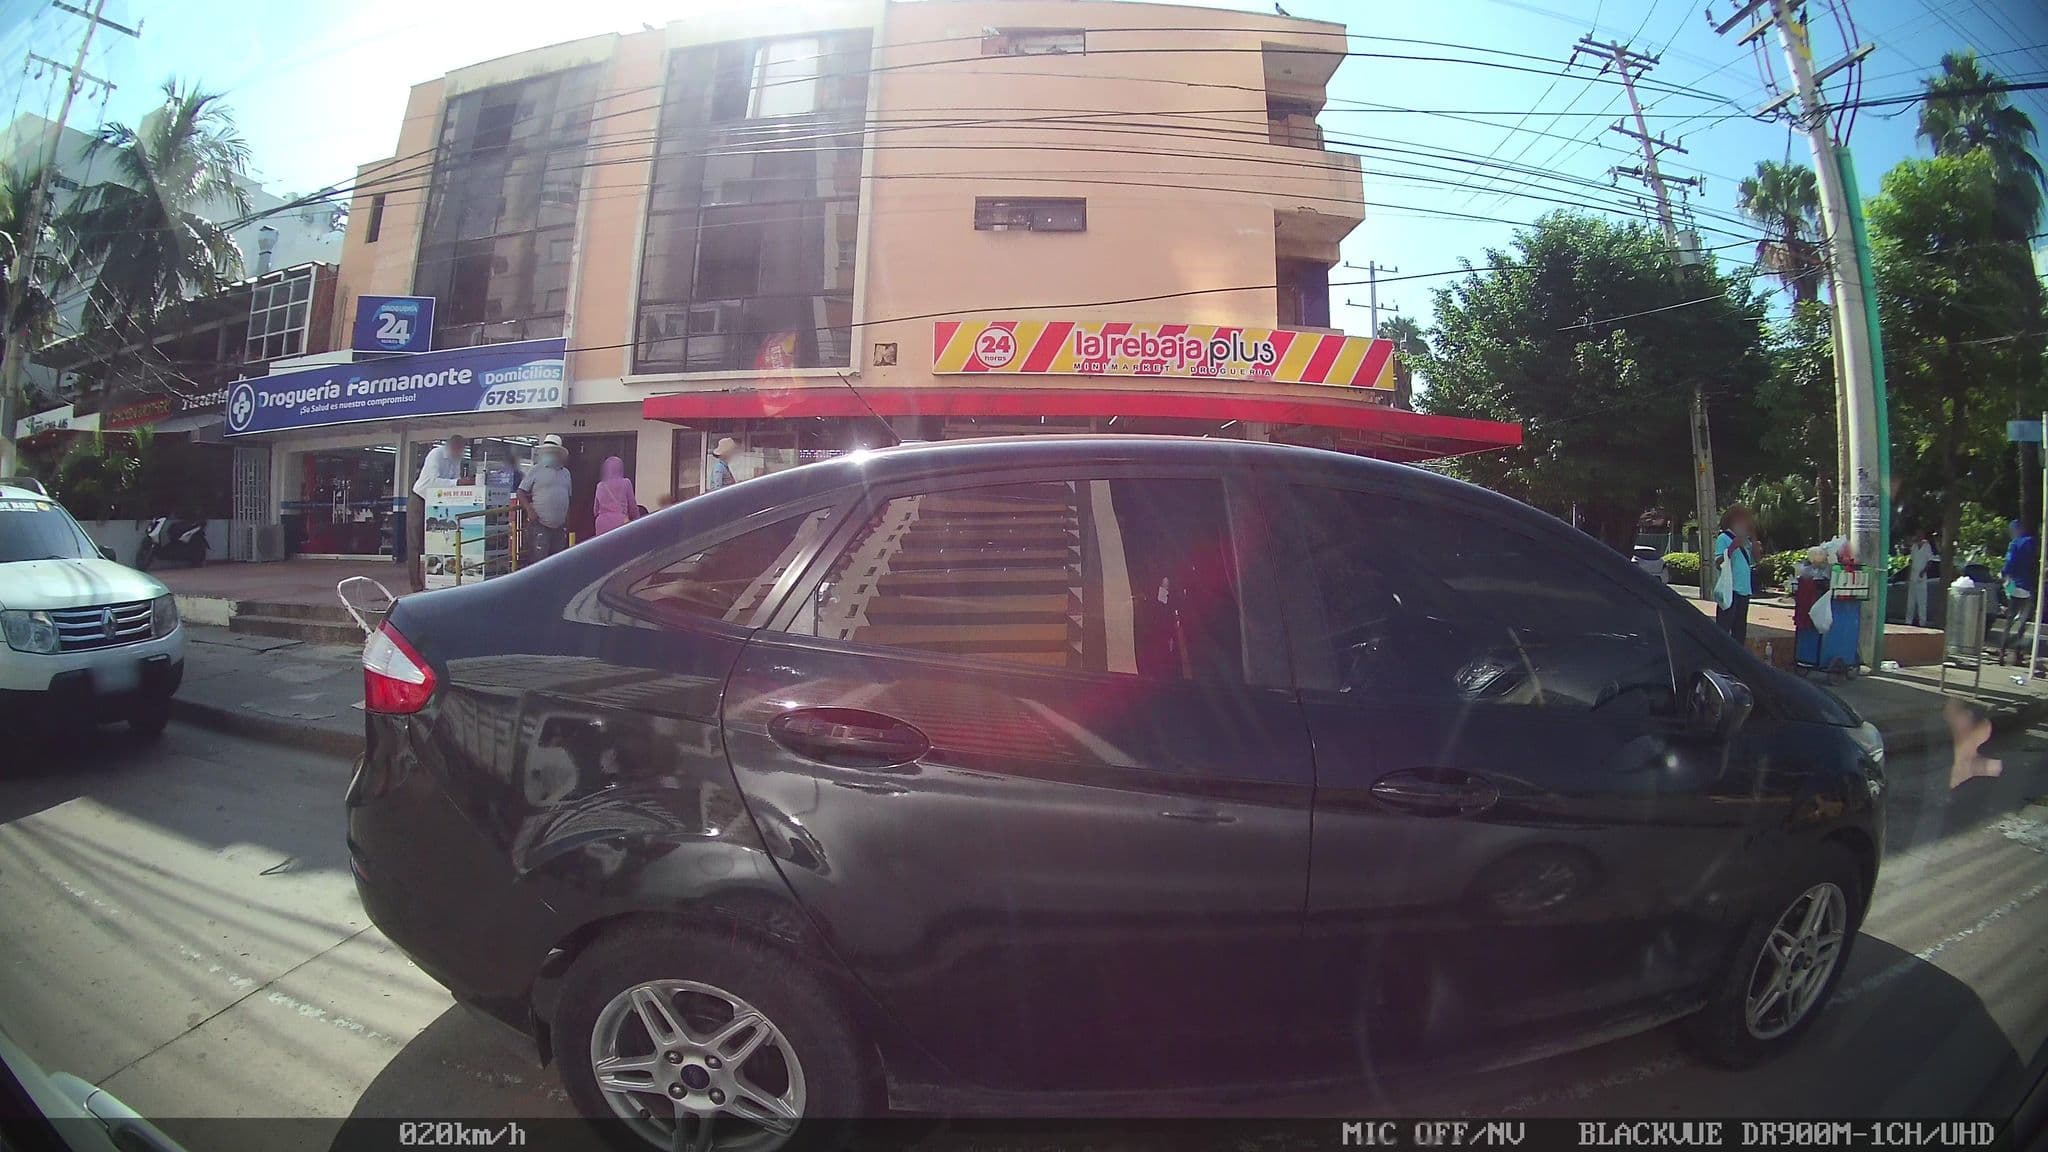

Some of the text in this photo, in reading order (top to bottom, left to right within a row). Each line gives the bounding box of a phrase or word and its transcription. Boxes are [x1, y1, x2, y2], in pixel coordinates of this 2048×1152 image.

[376, 312, 410, 345] 24
[981, 335, 1011, 353] 24
[1209, 333, 1275, 367] plus
[485, 366, 561, 385] Domicilios
[1073, 363, 1271, 377] MINIMARKET DROGUERIA
[258, 367, 473, 409] Droguería Farmanorte
[485, 387, 559, 406] 6785710
[311, 403, 329, 413] Salud
[330, 402, 338, 410] es
[339, 400, 366, 409] nuestro
[367, 394, 416, 407] compromiso!
